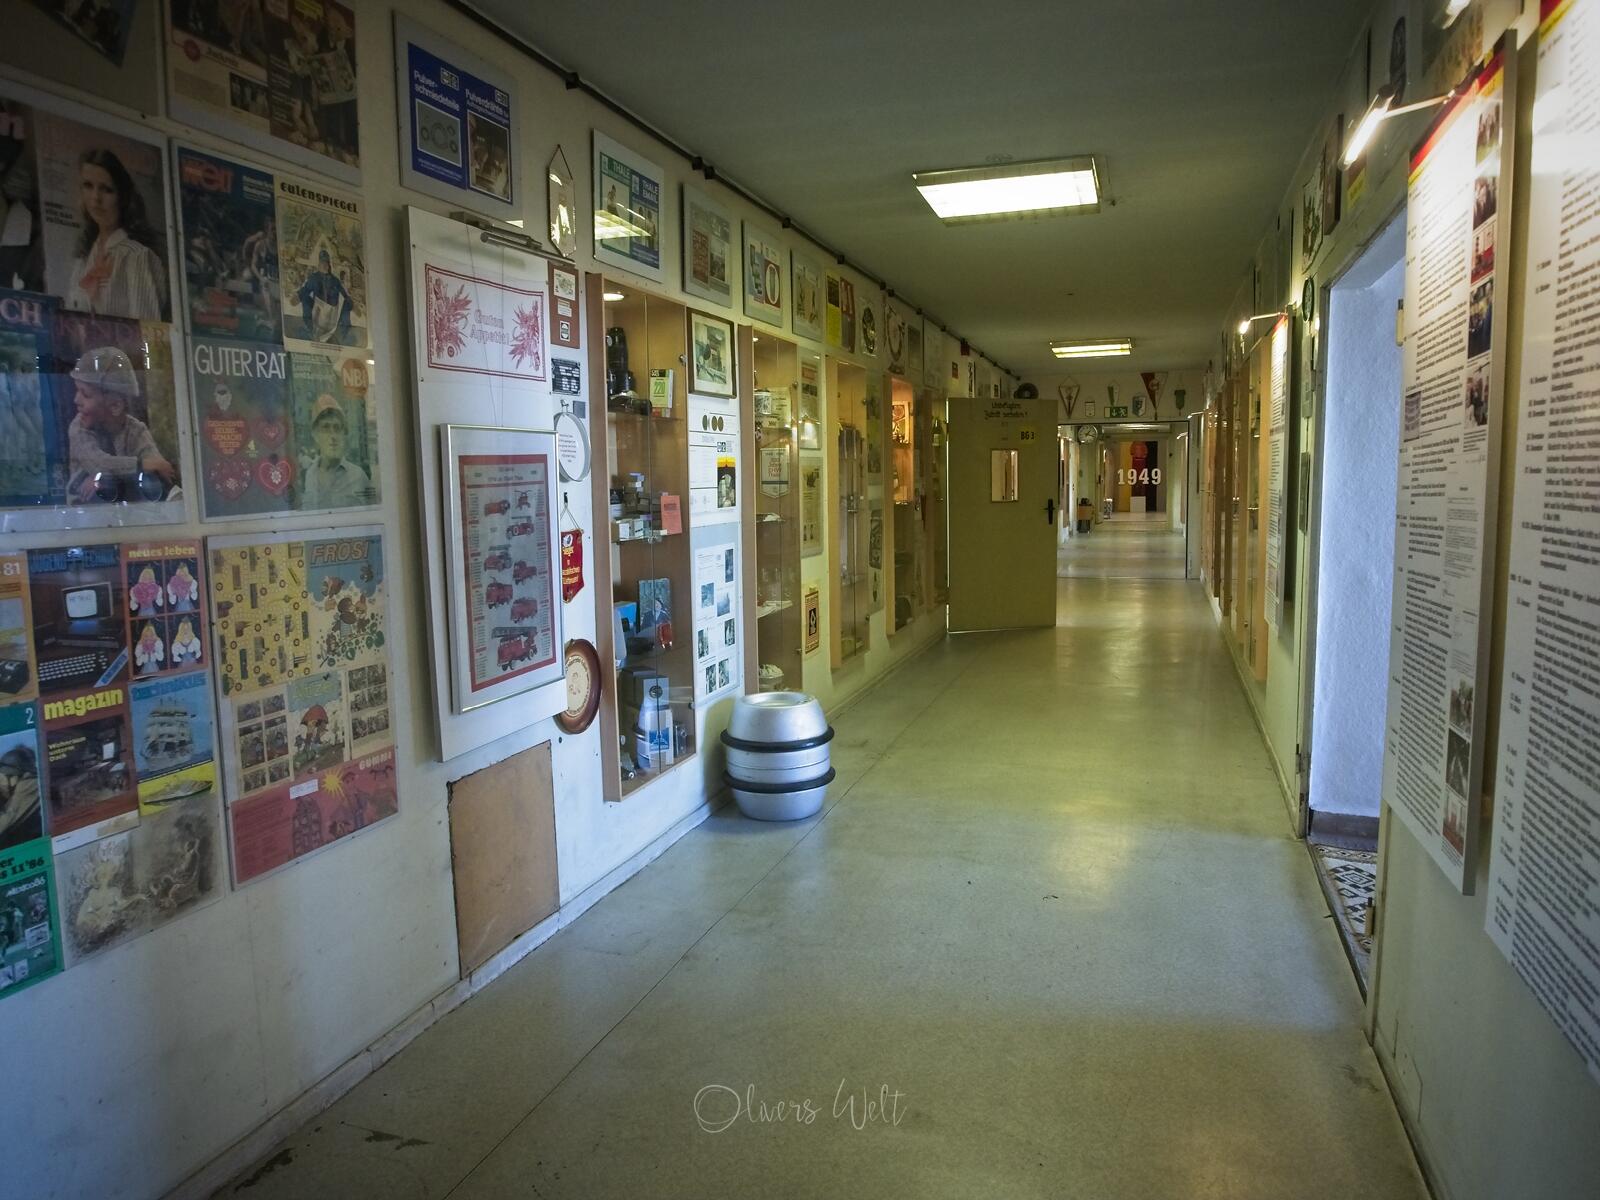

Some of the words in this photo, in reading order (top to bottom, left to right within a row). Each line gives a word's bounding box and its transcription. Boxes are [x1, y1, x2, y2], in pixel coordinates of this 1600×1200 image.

[279, 181, 358, 214] EULENSPIEGEL
[194, 344, 253, 378] GUTER
[254, 350, 287, 380] RAT
[1117, 468, 1162, 485] 1949
[128, 549, 161, 557] neues
[164, 546, 196, 556] leben
[25, 707, 34, 725] 2
[44, 688, 124, 721] magazin
